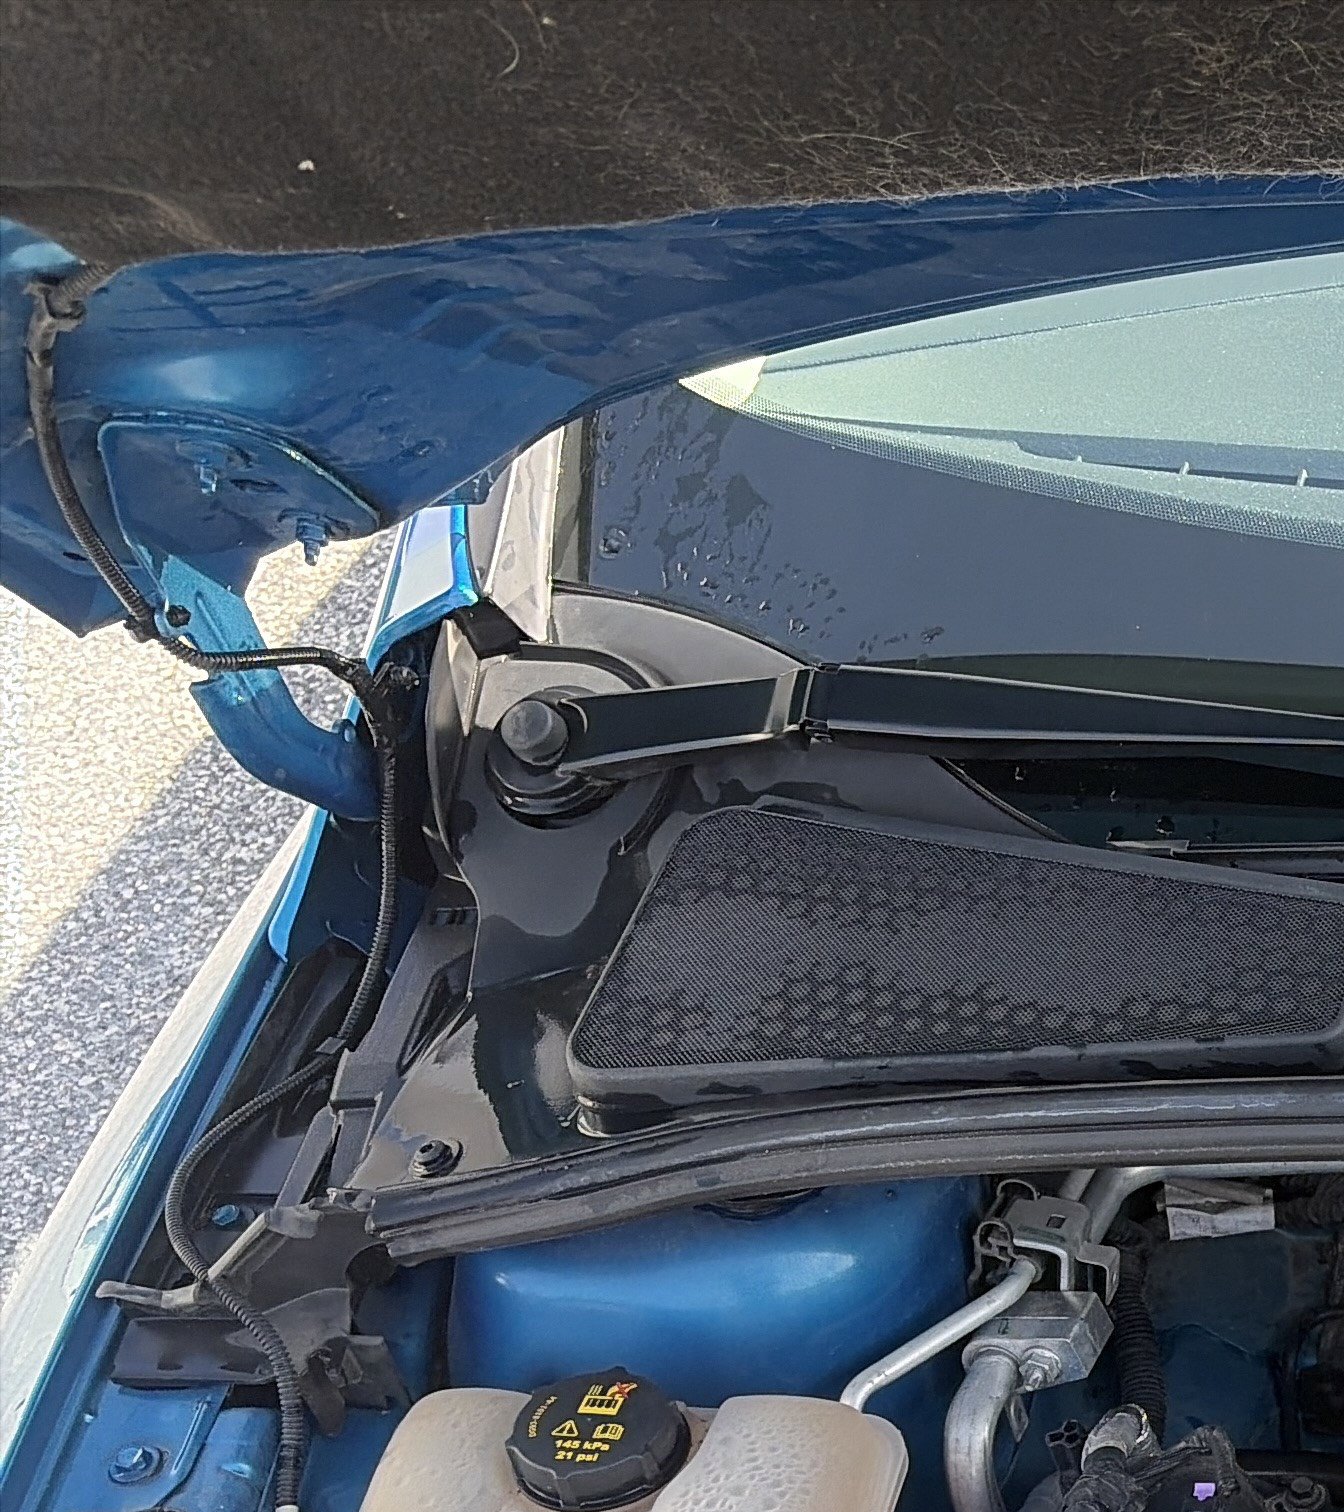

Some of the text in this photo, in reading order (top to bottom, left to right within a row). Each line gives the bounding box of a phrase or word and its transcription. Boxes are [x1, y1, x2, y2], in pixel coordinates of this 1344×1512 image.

[555, 1440, 610, 1450] 145 kPa
[555, 1452, 599, 1462] 21 psi
